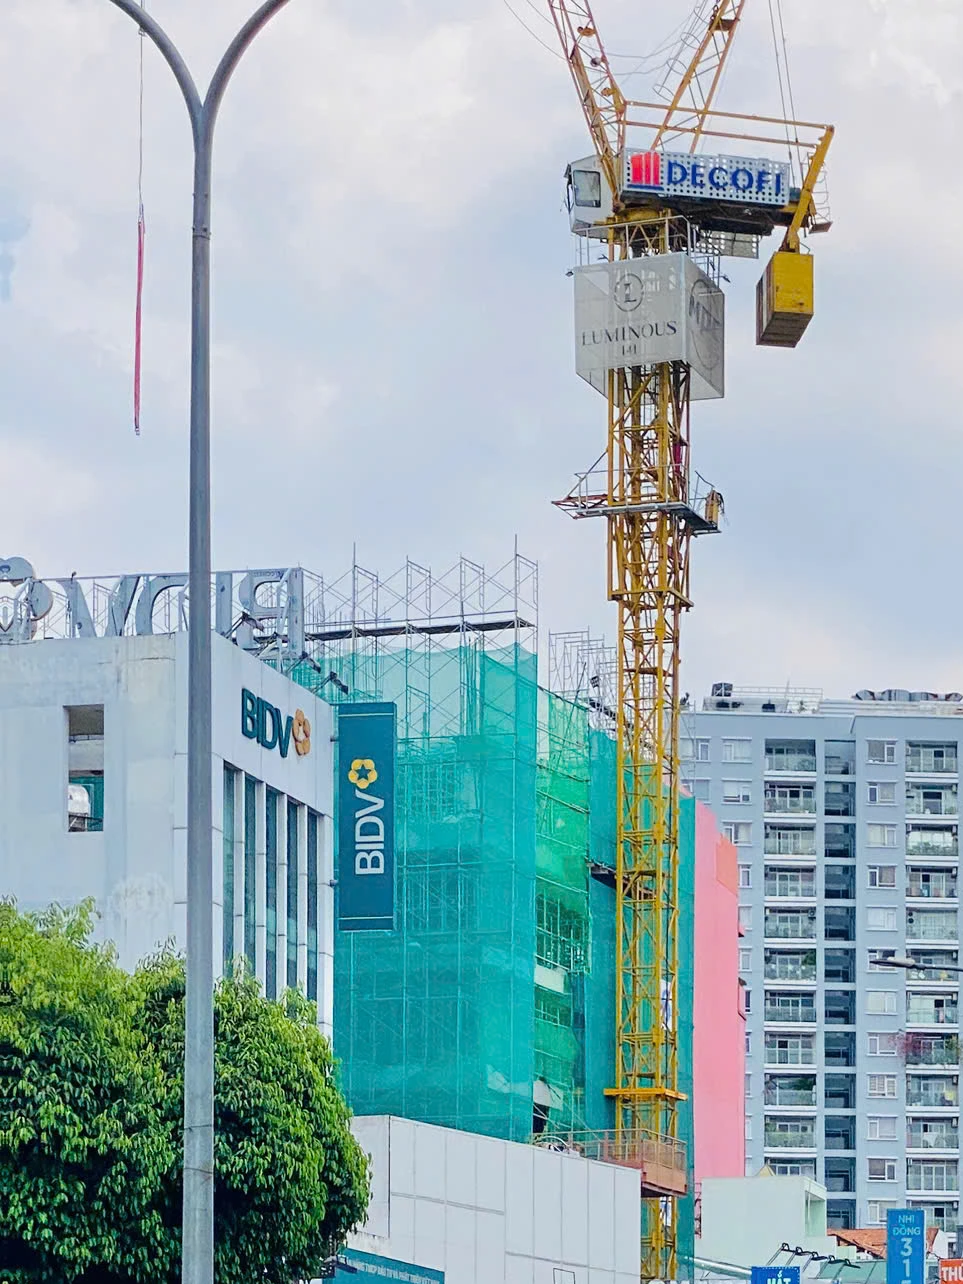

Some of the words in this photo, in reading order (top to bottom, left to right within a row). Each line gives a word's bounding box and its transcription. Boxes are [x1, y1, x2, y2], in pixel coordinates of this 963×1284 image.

[668, 160, 783, 196] DECOFI
[582, 320, 677, 346] LUMINOUS
[241, 687, 293, 758] BIDV
[355, 789, 385, 875] BIDV
